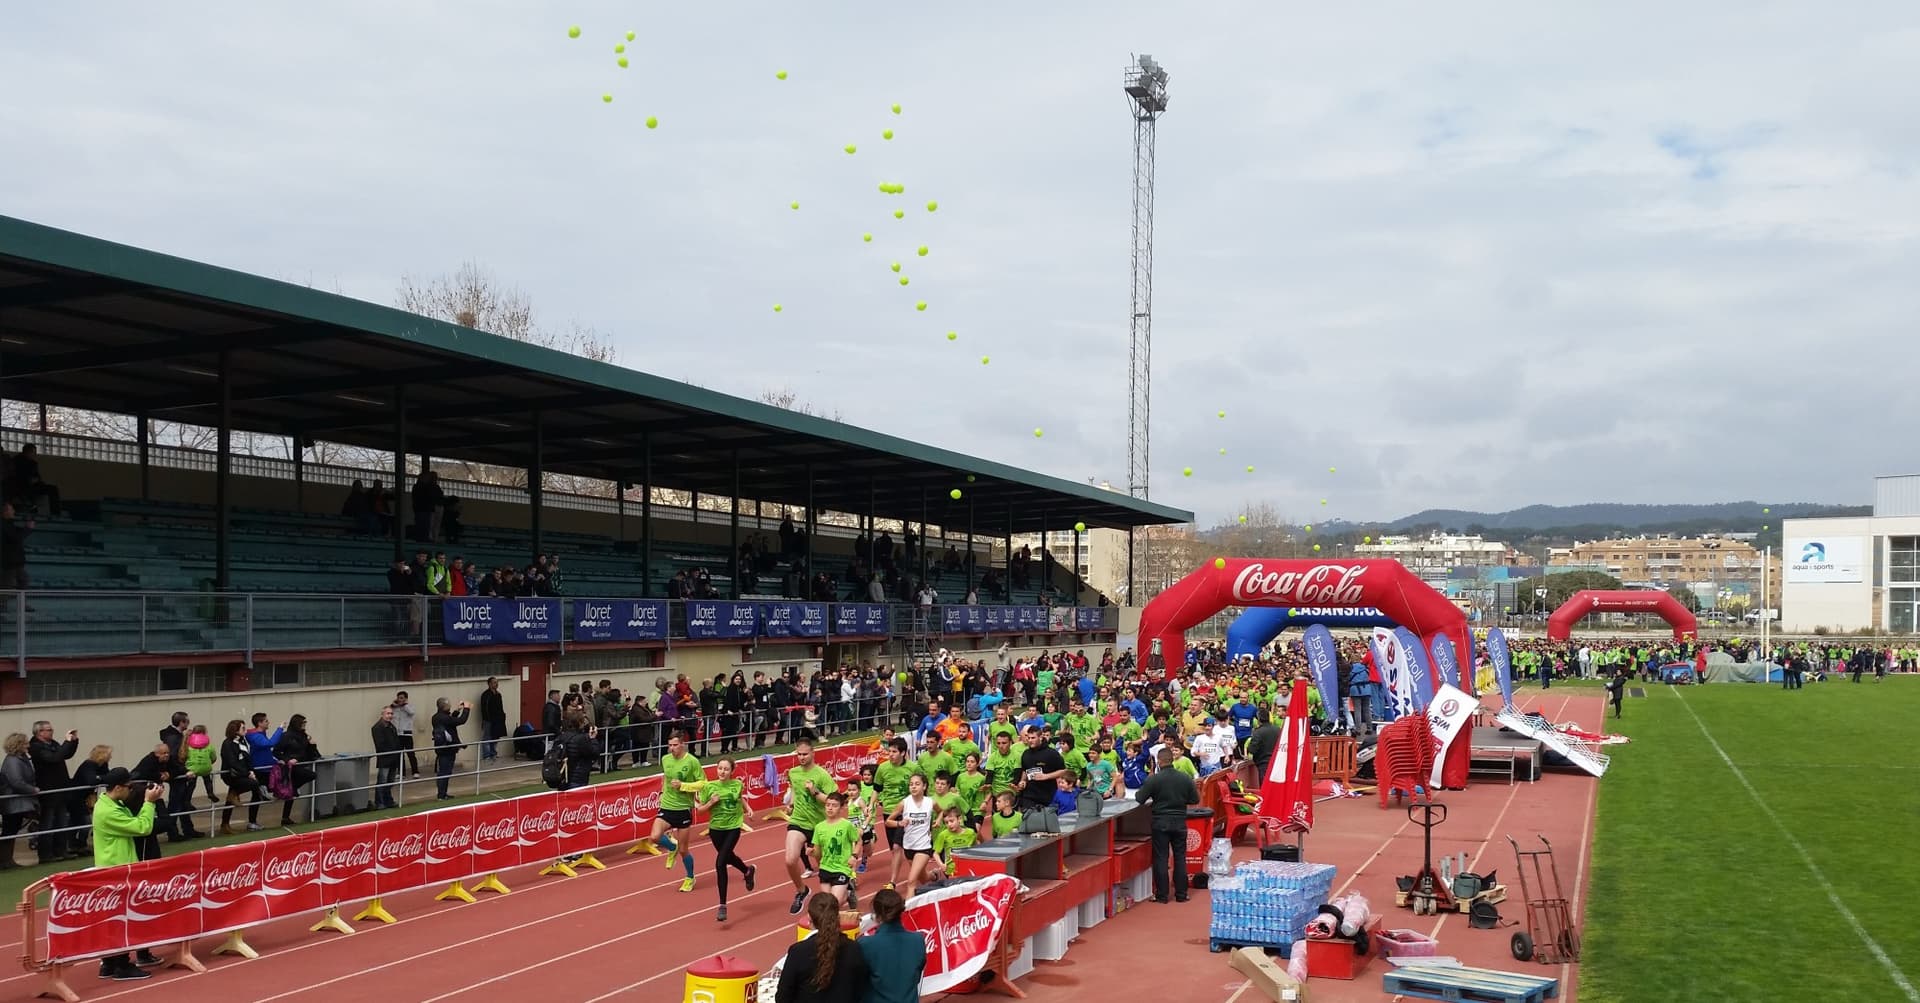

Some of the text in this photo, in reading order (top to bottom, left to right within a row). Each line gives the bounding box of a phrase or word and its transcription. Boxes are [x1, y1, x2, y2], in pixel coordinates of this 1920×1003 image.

[1233, 564, 1368, 603] Coca-Cola
[460, 602, 492, 621] lloret
[519, 603, 547, 621] lloret
[585, 603, 612, 620] lloret
[633, 603, 657, 620] lloret
[696, 604, 717, 619] lloret
[733, 605, 754, 619] lloret
[1432, 716, 1450, 731] SYM
[560, 802, 594, 827] Coca-Cola
[598, 796, 630, 819] Coca-Cola
[476, 817, 516, 843] Coca-Cola
[520, 810, 556, 834] Coca-Cola
[377, 833, 424, 861] Coca-Cola
[428, 824, 471, 851] Coca-Cola
[264, 850, 318, 882] Coca-Cola
[323, 841, 373, 871] Coca-Cola
[130, 872, 199, 905] Coca-Cola
[205, 861, 260, 894] Coca-Cola
[51, 883, 127, 918] Coca-Cola
